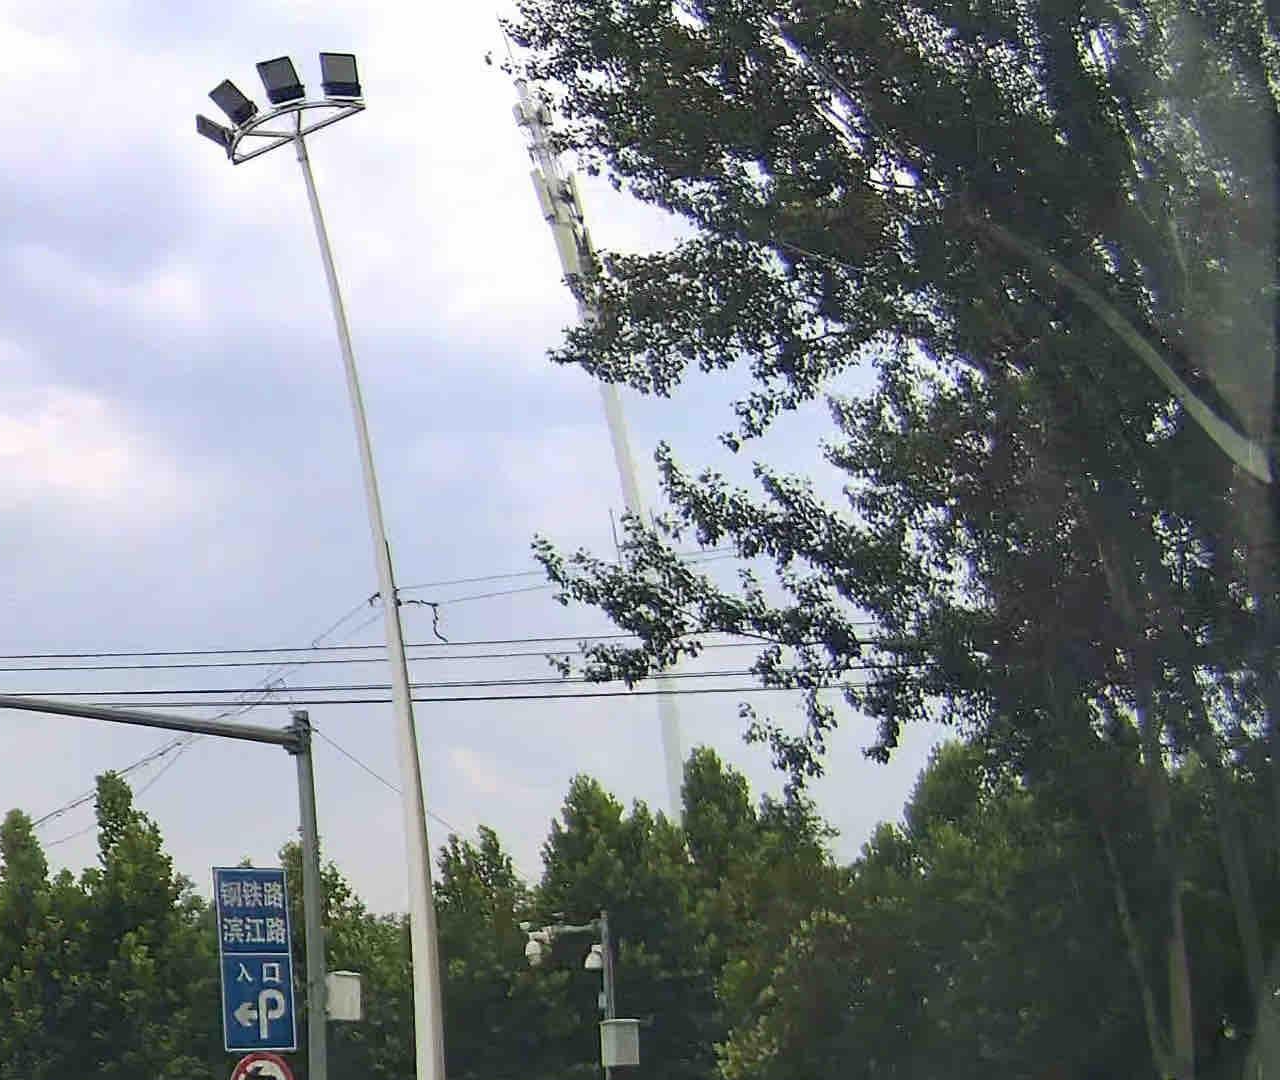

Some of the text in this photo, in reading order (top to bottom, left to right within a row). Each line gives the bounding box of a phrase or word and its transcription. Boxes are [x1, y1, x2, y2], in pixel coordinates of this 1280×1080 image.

[223, 917, 286, 944] 滨江路
[236, 962, 281, 983] 入口
